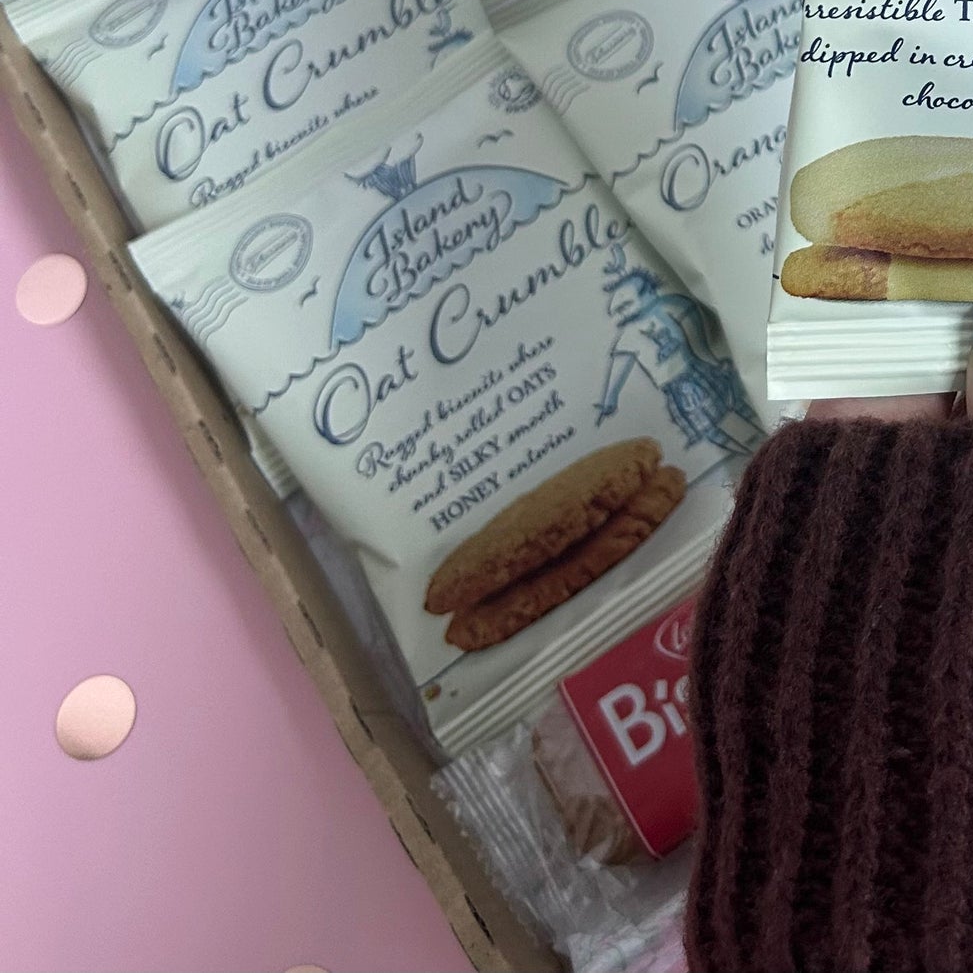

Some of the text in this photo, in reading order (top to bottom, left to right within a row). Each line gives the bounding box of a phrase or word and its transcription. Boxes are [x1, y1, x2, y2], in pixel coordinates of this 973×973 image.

[800, 38, 903, 78] dipped
[908, 47, 938, 68] in
[155, 91, 250, 183] Oat
[364, 177, 484, 267] Island
[364, 189, 514, 305] Bakery
[313, 344, 420, 446] Oat
[429, 202, 637, 367] Crumble
[355, 334, 555, 480] Ragged biscuits where
[388, 361, 558, 494] chunky rolled OATS
[411, 388, 566, 514] and SILKY smooth
[428, 425, 578, 533] HONEY entwine
